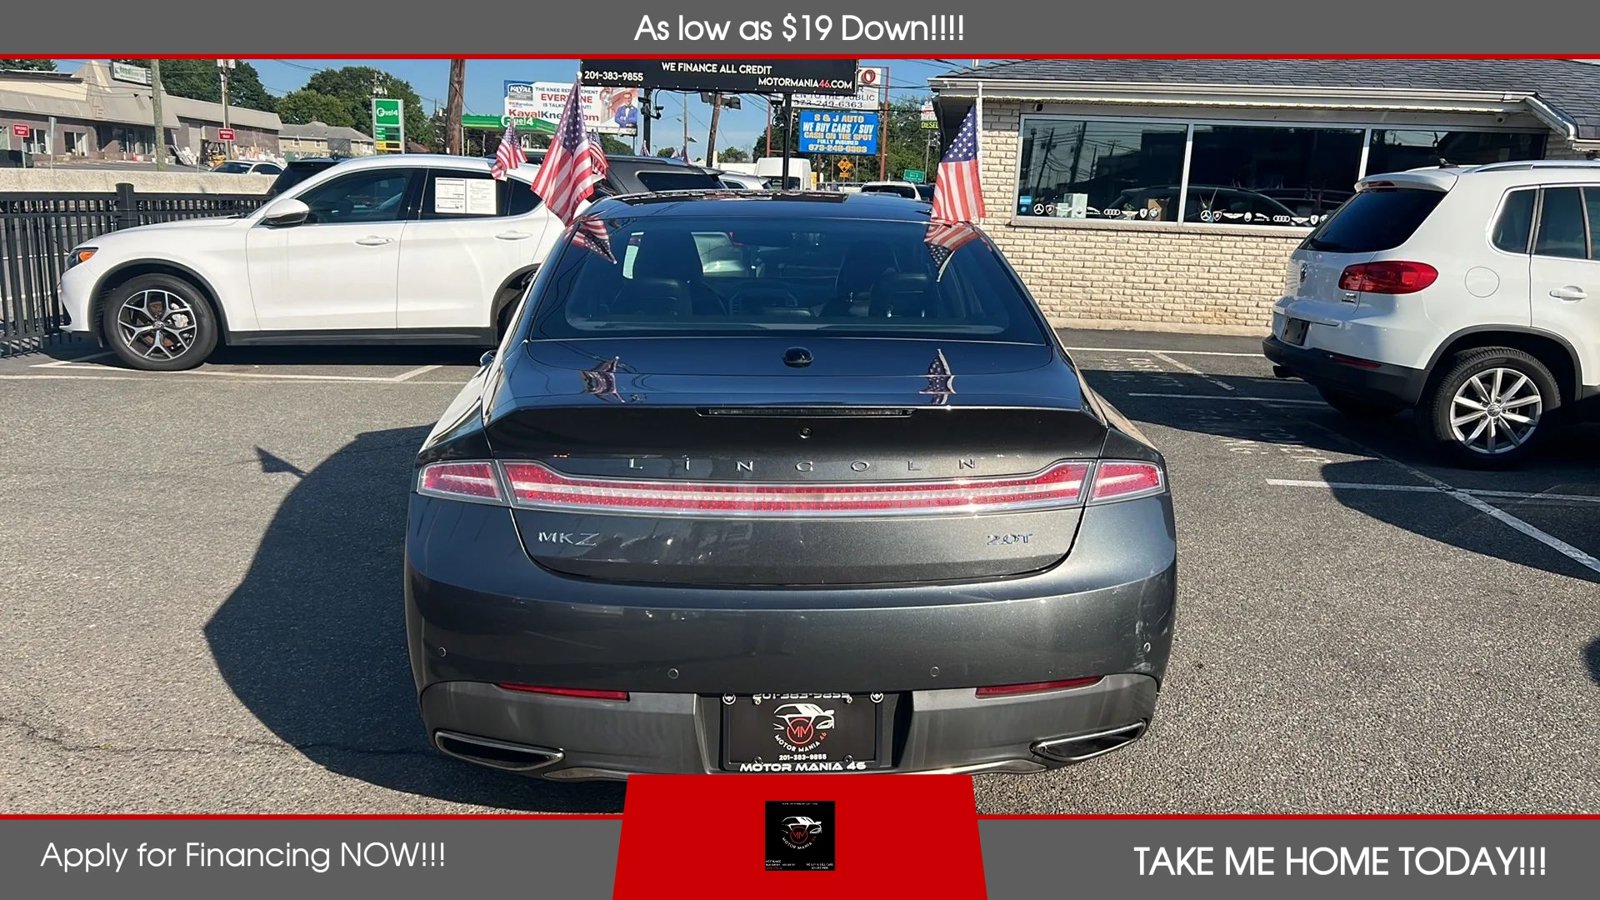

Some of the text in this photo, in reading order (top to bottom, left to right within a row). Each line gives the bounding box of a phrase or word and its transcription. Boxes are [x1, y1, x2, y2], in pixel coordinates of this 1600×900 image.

[661, 62, 773, 75] WE FINANCE ALL CREDIT
[584, 70, 644, 82] 201-383-9855
[758, 77, 853, 90] MOTORMANIA46.COM
[541, 93, 593, 104] EVERNE
[841, 114, 865, 123] AUTO
[803, 121, 814, 132] WE
[815, 122, 831, 132] BUY
[831, 123, 852, 134] CARS
[628, 457, 976, 472] LINCOLN
[538, 532, 600, 546] MKZ
[774, 734, 797, 752] MOTOR
[798, 741, 821, 752] MANIA
[739, 761, 867, 772] MOTOR MANIA 46
